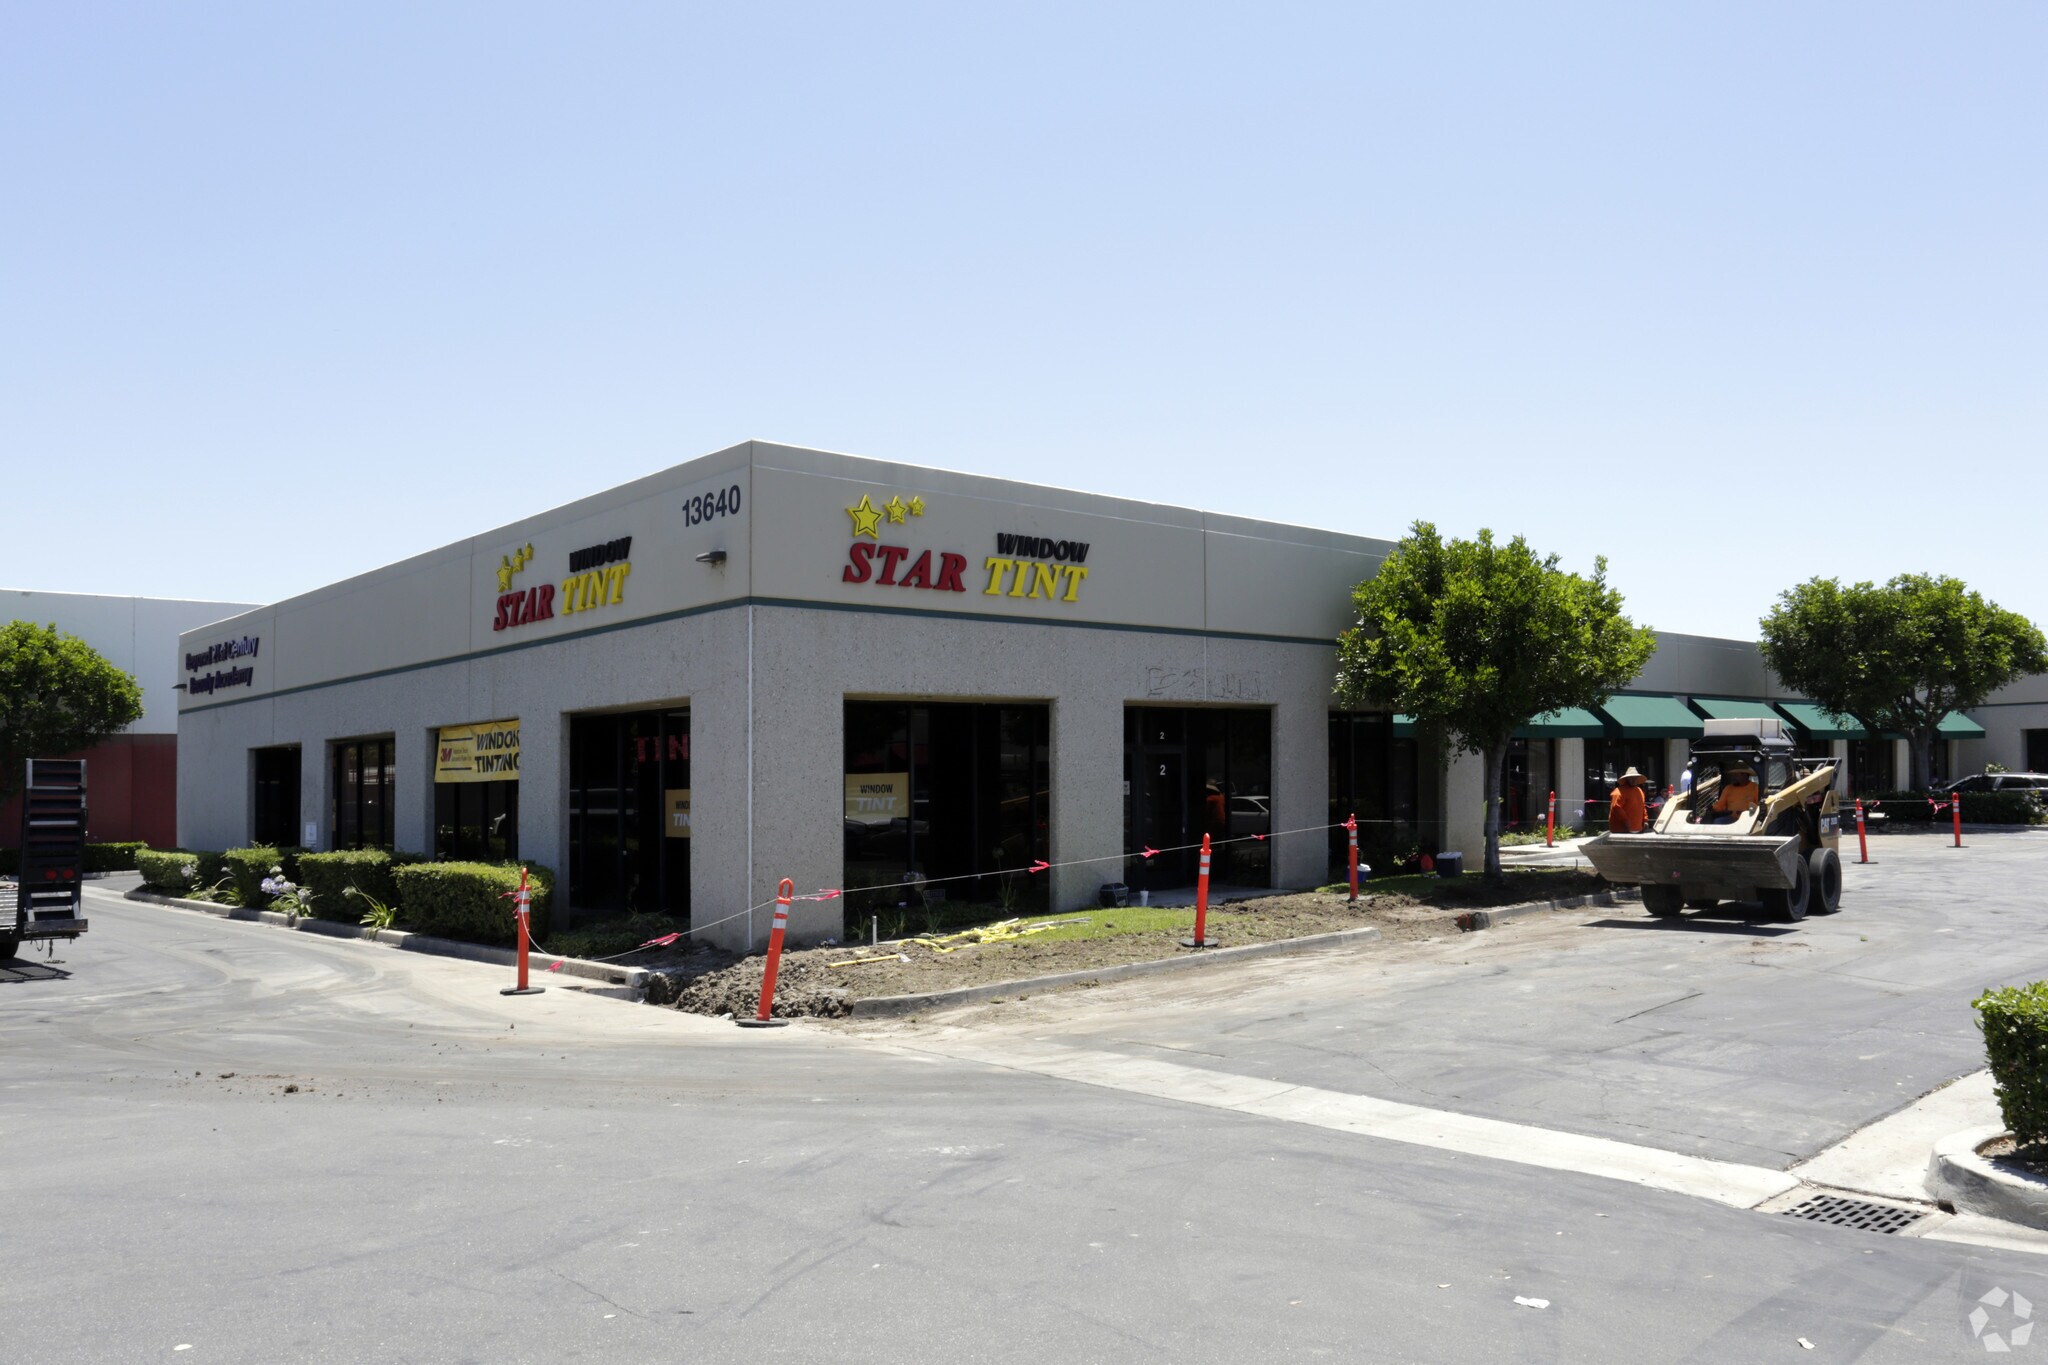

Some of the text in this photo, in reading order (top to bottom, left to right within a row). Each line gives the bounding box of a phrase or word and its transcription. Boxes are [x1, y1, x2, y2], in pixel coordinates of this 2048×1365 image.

[682, 485, 741, 528] 13640
[569, 536, 632, 573] WINDOW
[996, 532, 1090, 563] WINDOW
[842, 542, 1089, 602] STAR TINT
[493, 562, 632, 631] STAR TINT
[228, 636, 260, 659] Century
[1160, 732, 1165, 740] 2
[441, 748, 453, 762] 3M
[1160, 765, 1166, 775] 2
[860, 783, 894, 794] WINDOW
[856, 796, 897, 811] TINT
